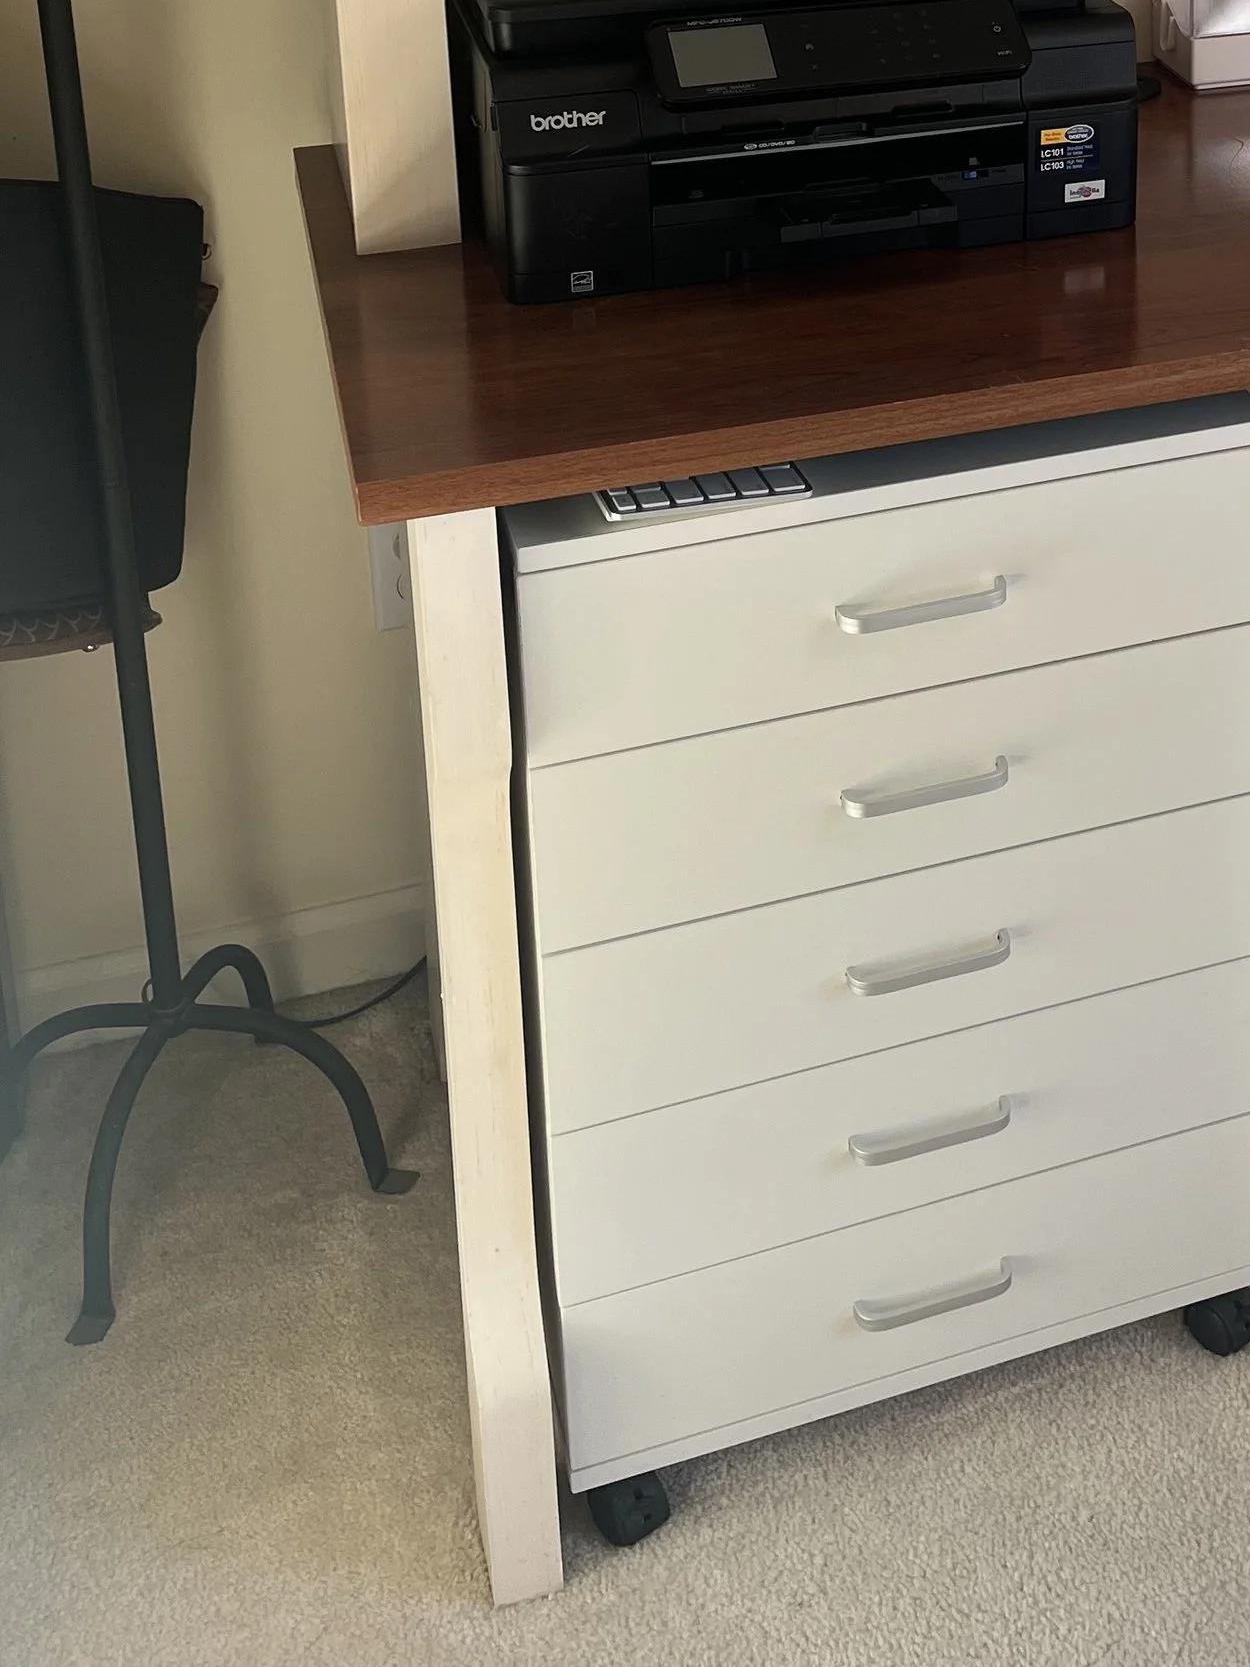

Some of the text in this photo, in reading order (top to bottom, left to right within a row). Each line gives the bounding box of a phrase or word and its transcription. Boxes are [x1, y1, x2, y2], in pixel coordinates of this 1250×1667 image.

[530, 110, 607, 132] brother
[1040, 148, 1064, 158] LC101
[1040, 161, 1065, 172] LC103
